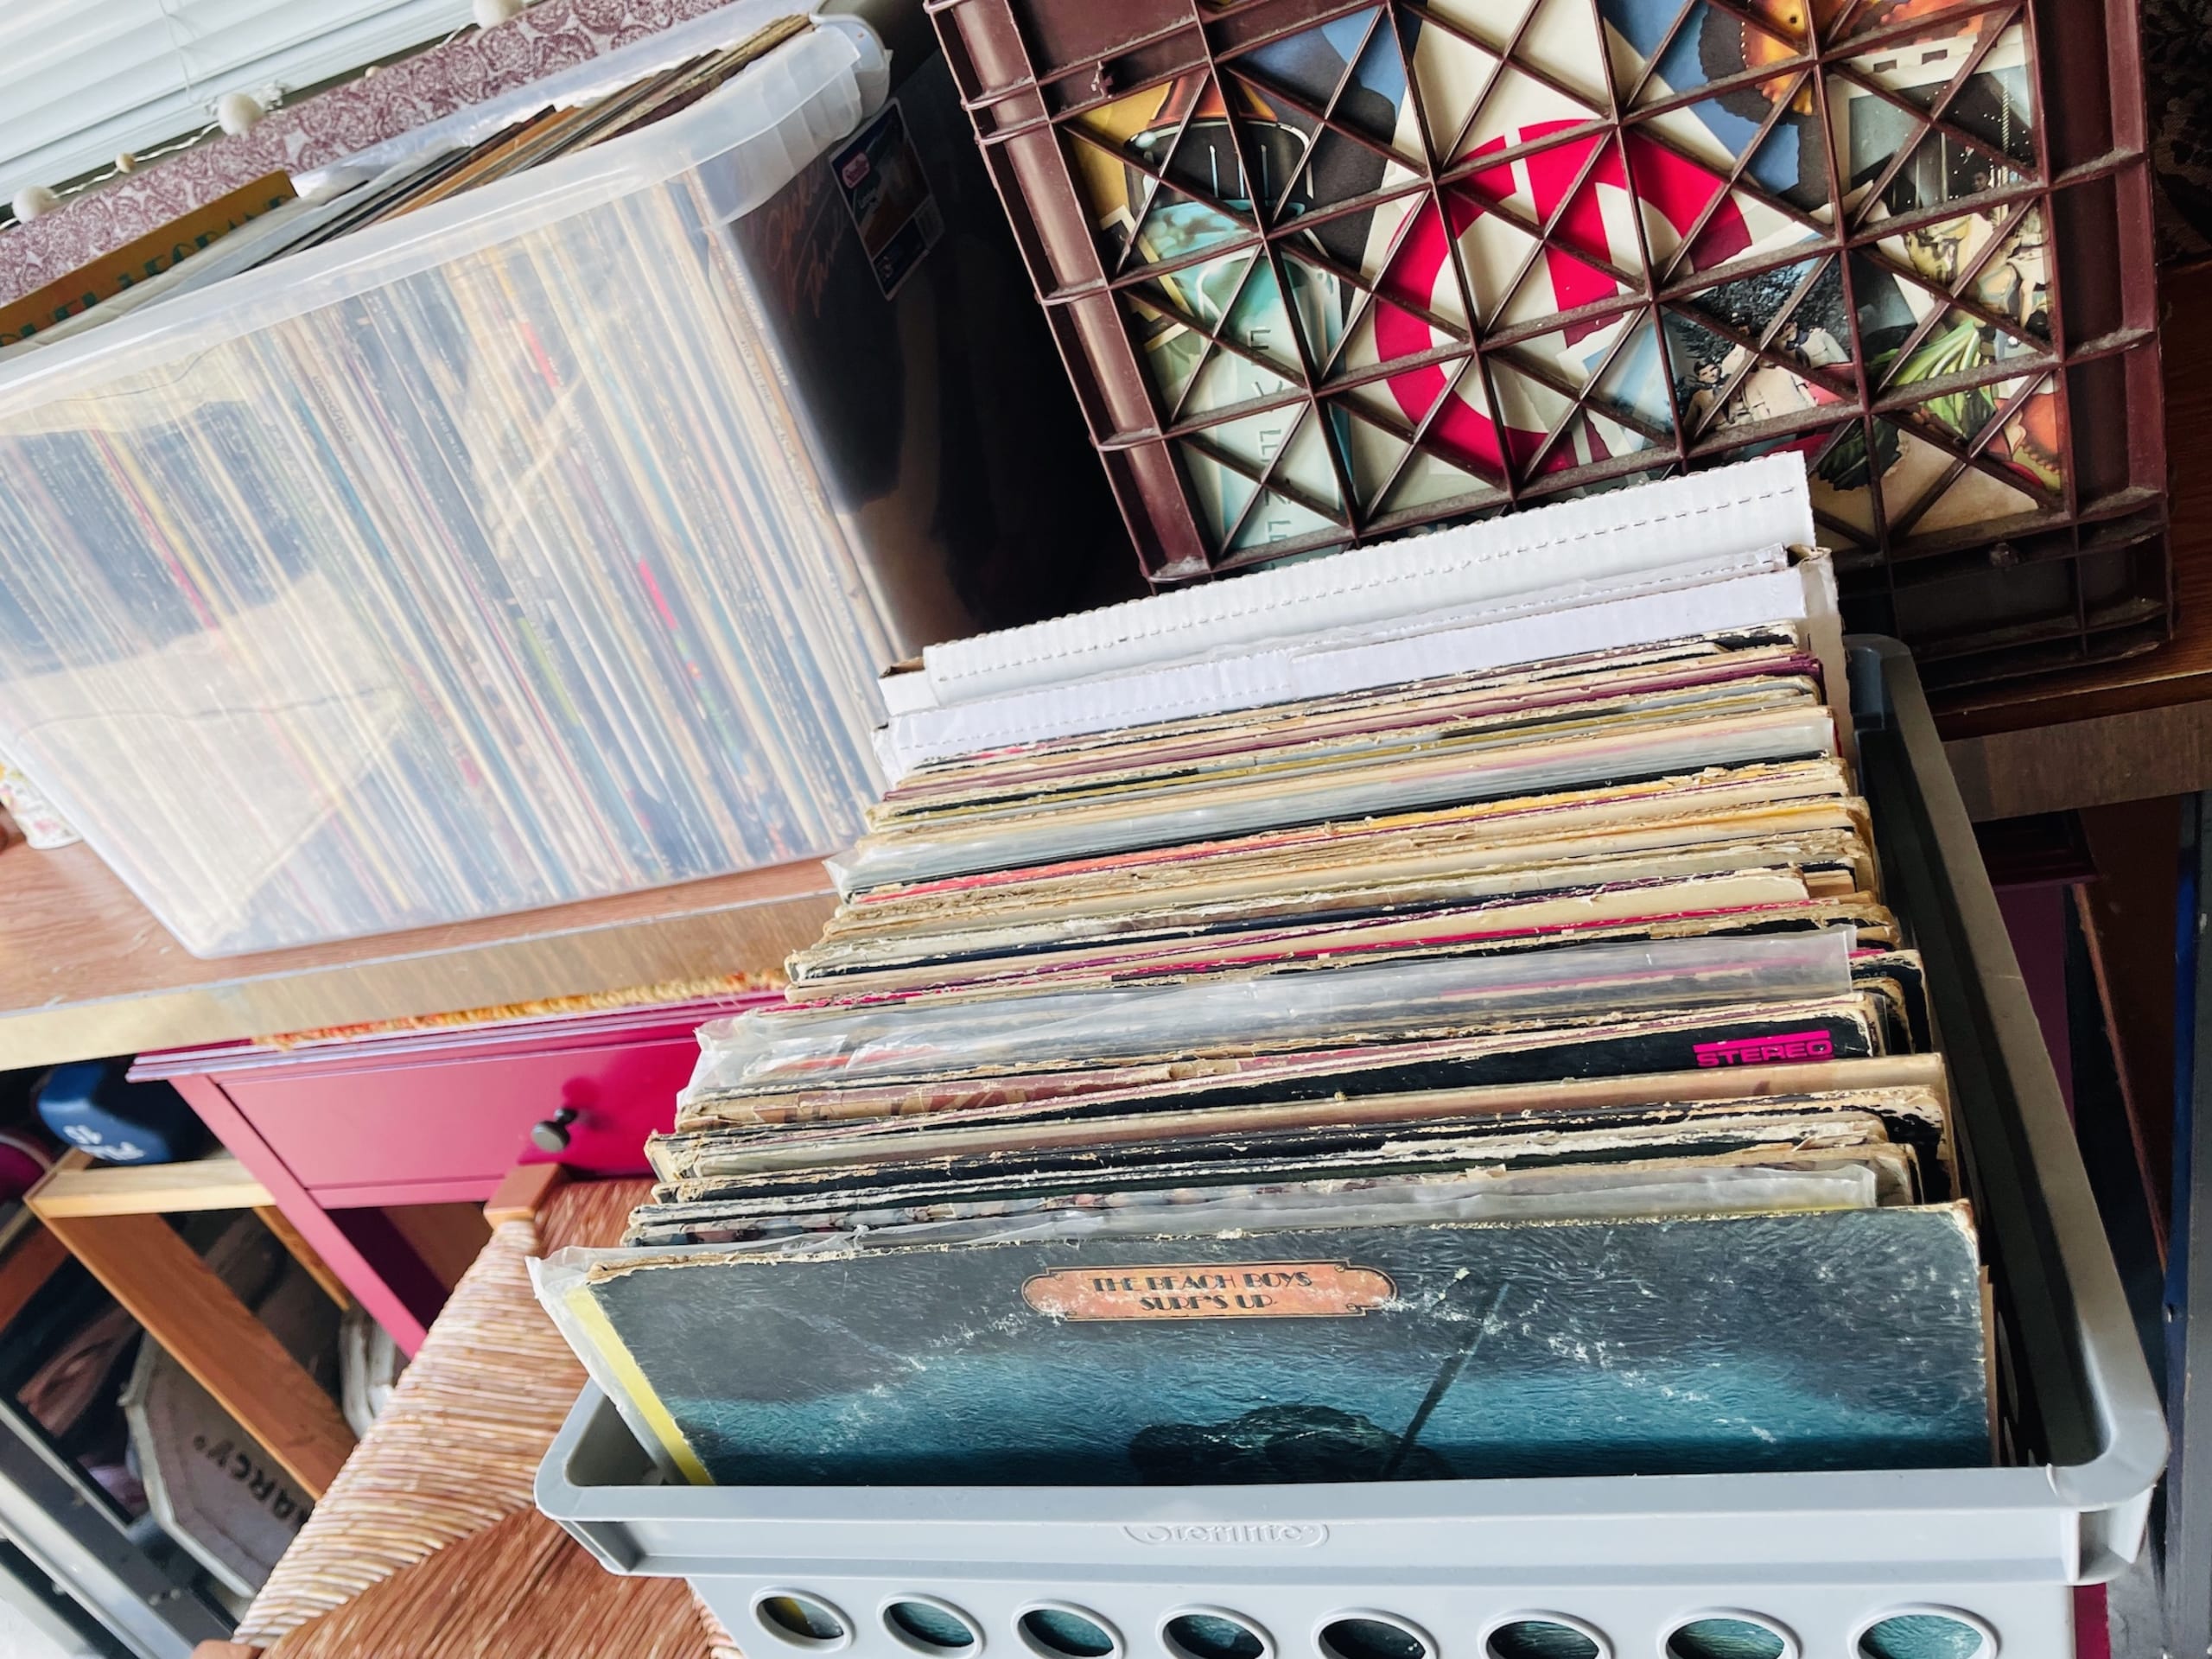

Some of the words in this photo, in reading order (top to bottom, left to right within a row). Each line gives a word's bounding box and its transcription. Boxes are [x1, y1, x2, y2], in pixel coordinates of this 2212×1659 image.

[1696, 1040, 1834, 1067] STEREO
[1089, 1278, 1141, 1292] THE
[1146, 1274, 1236, 1291] BEACH
[1242, 1271, 1313, 1288] BOYS
[1139, 1295, 1229, 1311] SURF'S
[206, 1439, 309, 1531] ARCY
